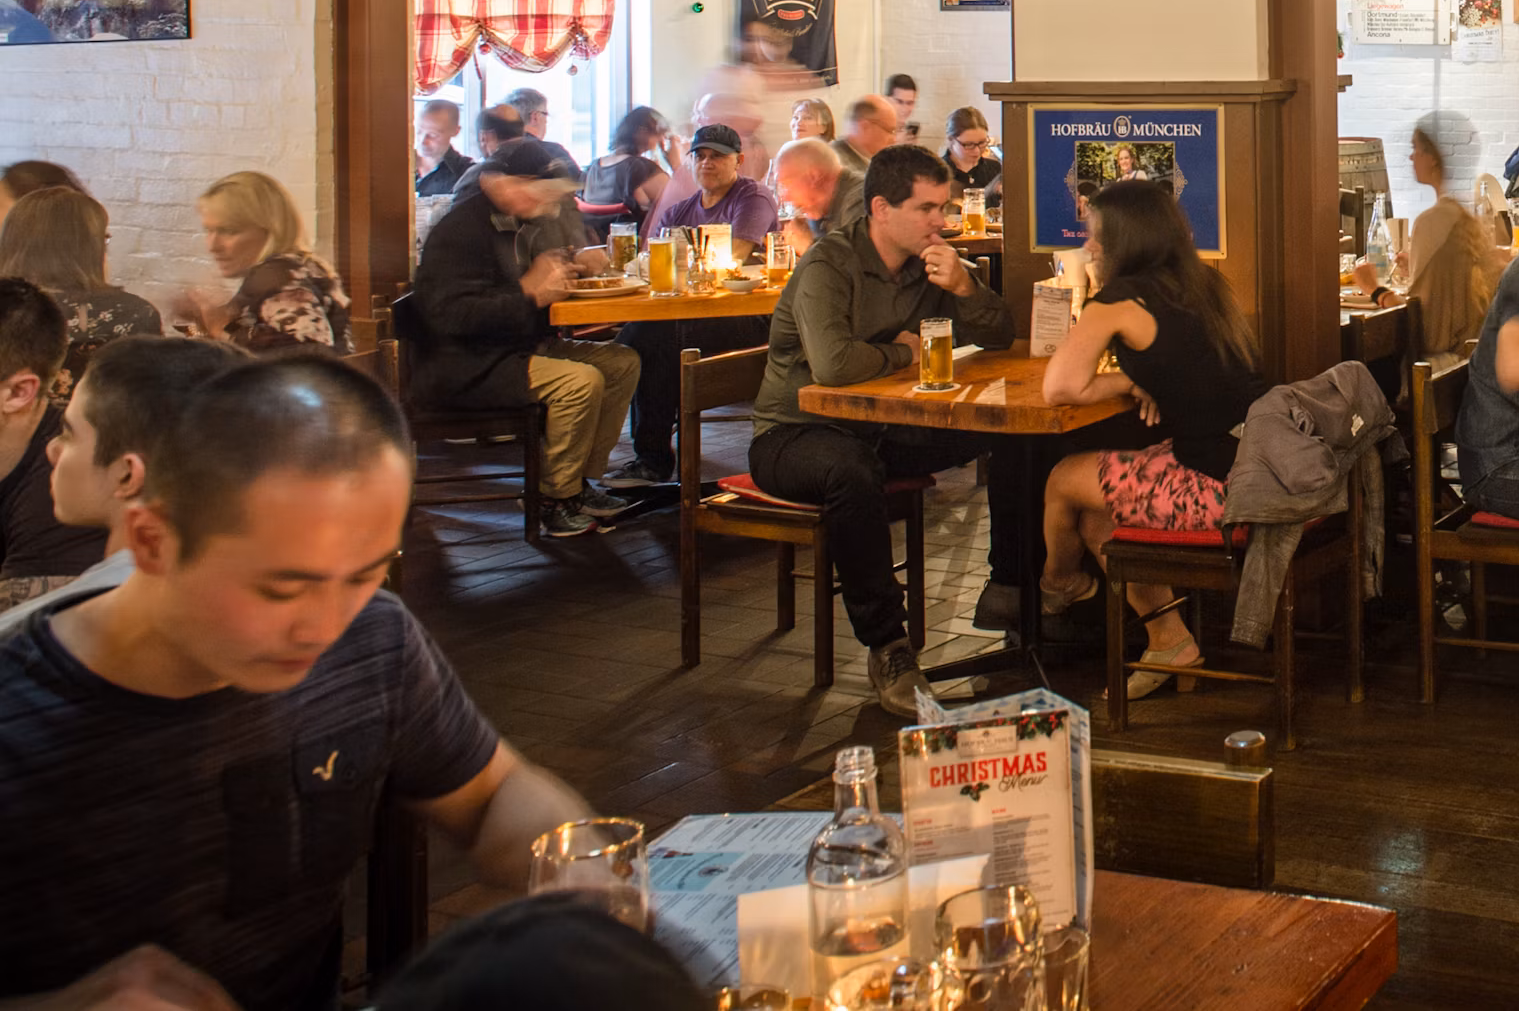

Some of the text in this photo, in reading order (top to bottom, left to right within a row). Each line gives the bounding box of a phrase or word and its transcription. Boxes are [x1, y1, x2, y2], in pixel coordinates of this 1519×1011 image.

[1051, 121, 1111, 137] HOFBRÄU
[1133, 121, 1202, 137] MÜNCHEN
[930, 751, 1047, 789] CHRISTMAS
[998, 771, 1049, 793] Menu
